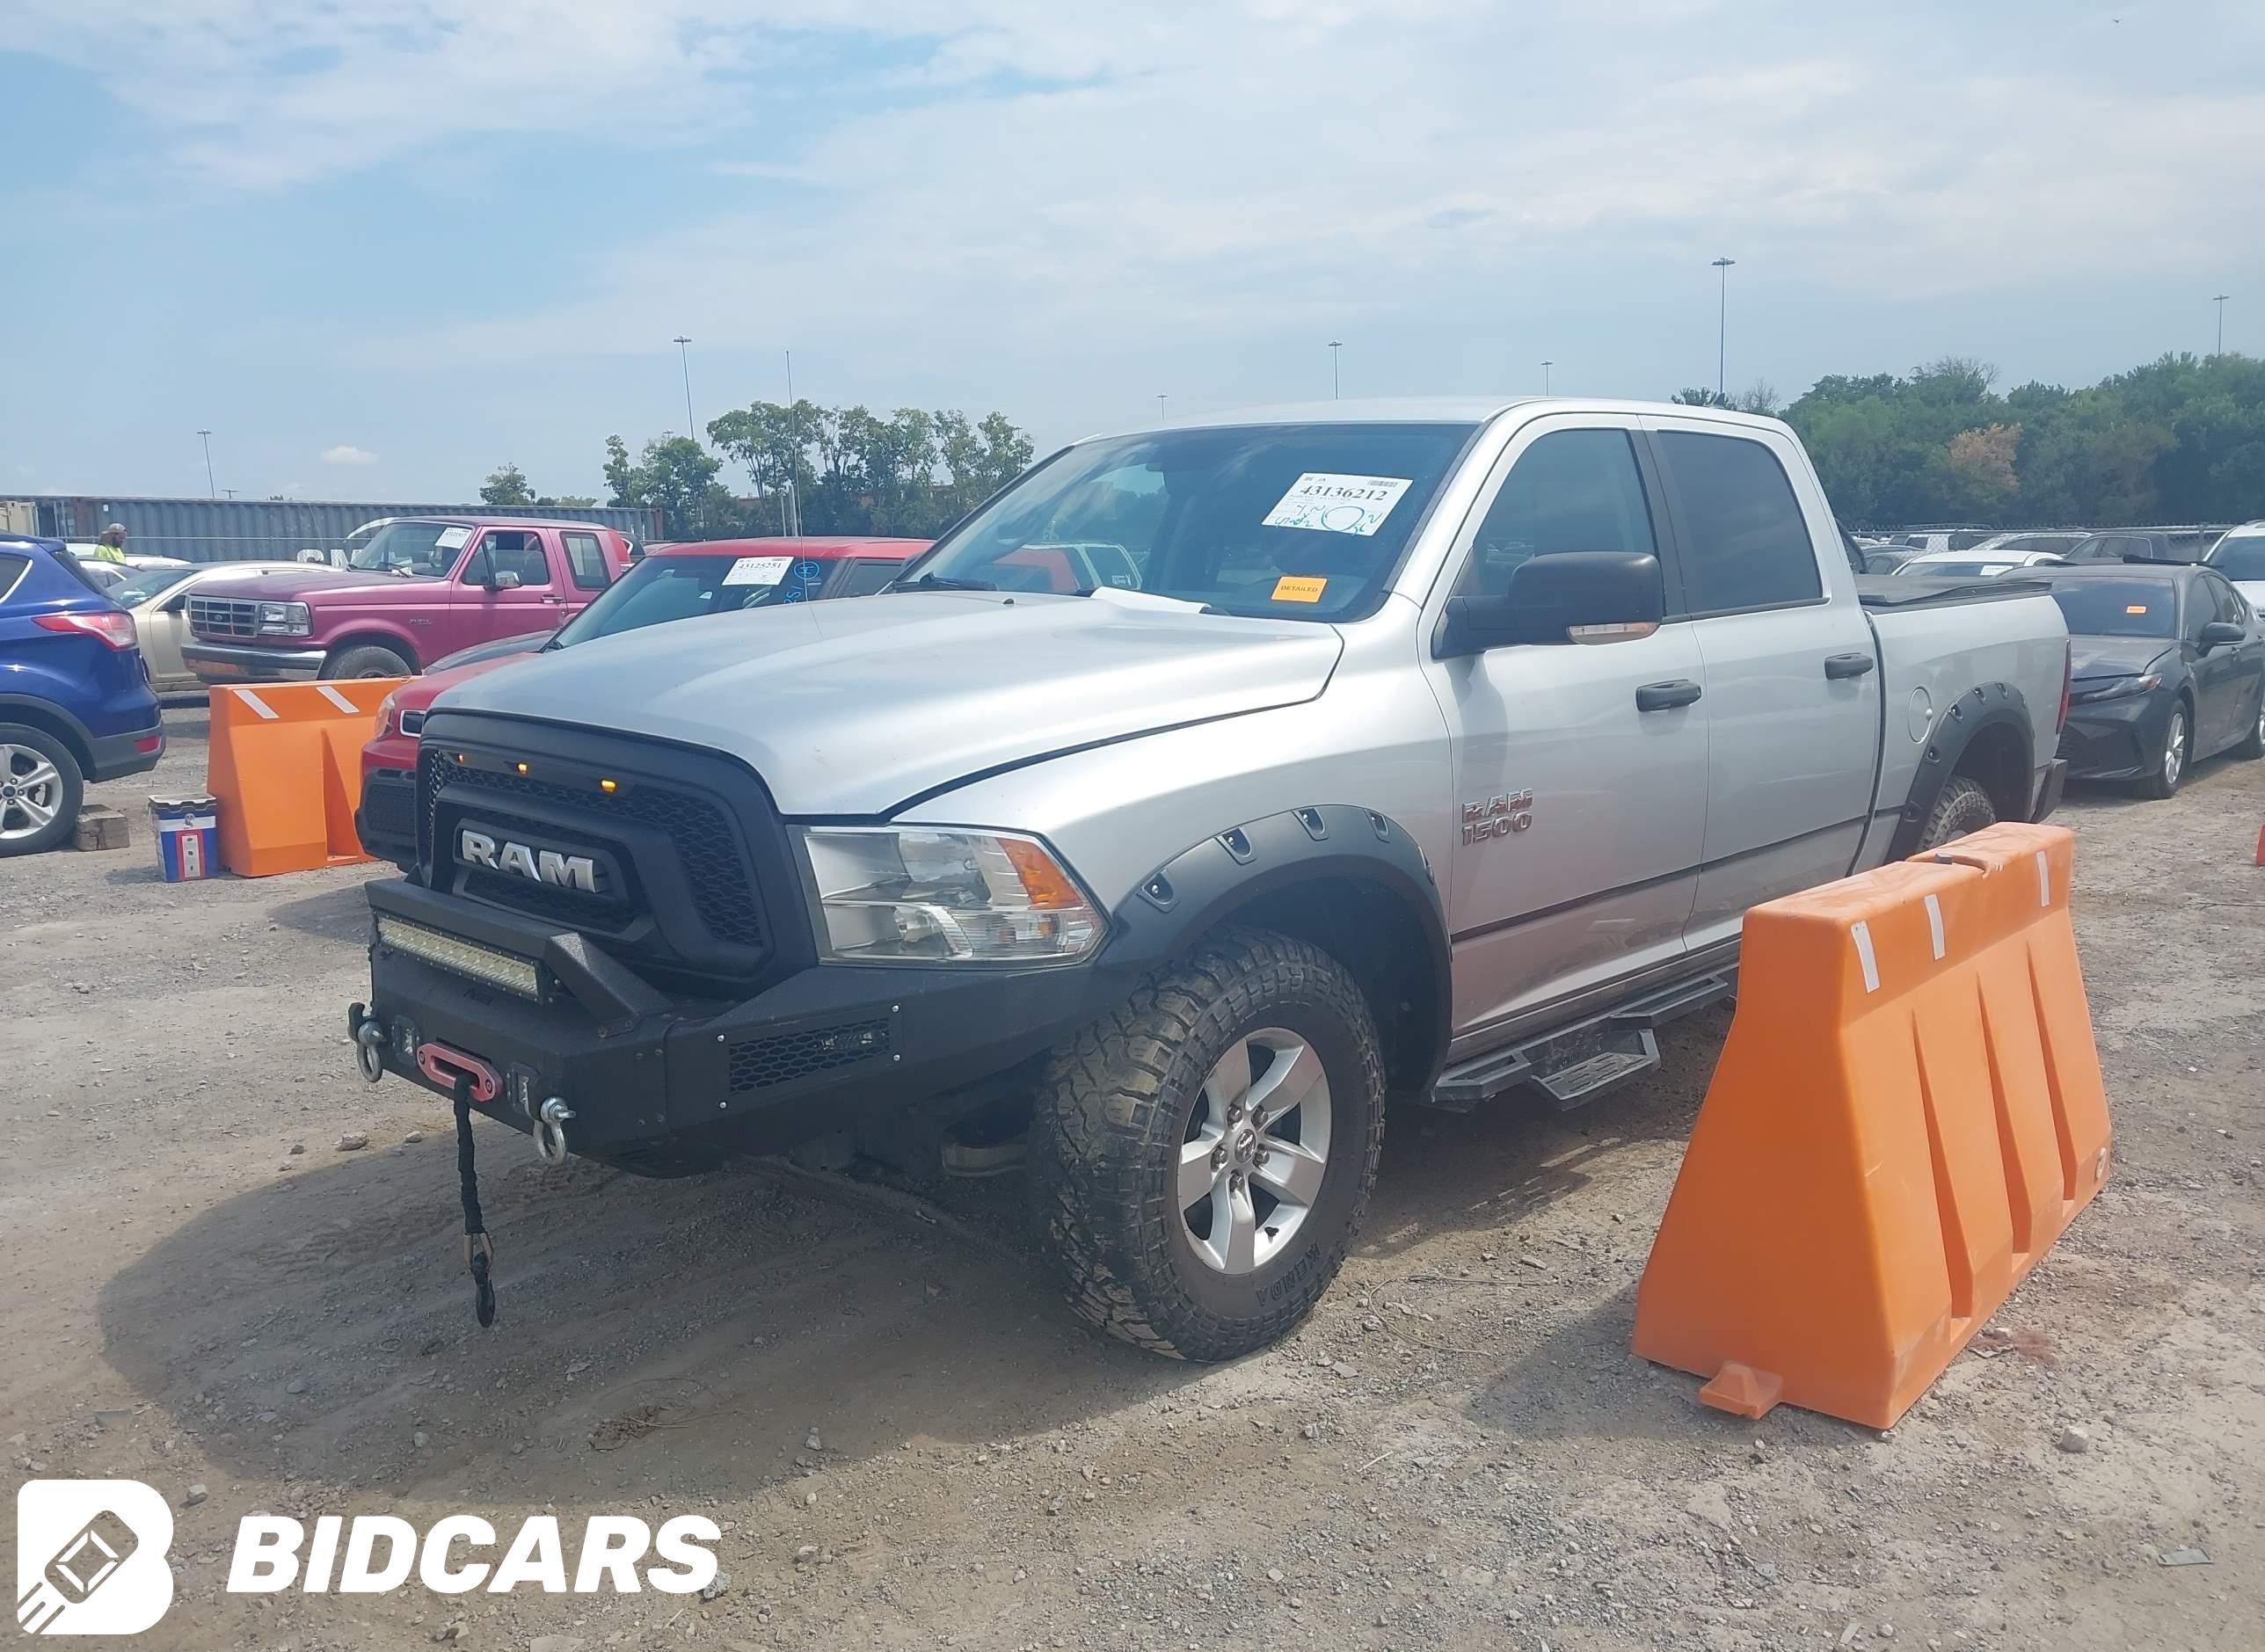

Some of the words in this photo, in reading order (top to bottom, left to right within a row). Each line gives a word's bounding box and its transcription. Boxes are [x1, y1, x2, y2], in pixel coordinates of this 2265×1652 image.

[1300, 485, 1387, 501] 43136212
[1462, 788, 1533, 824] RAM
[1461, 811, 1533, 845] 1500
[462, 829, 596, 893] RAM
[1255, 1240, 1321, 1306] KENDA
